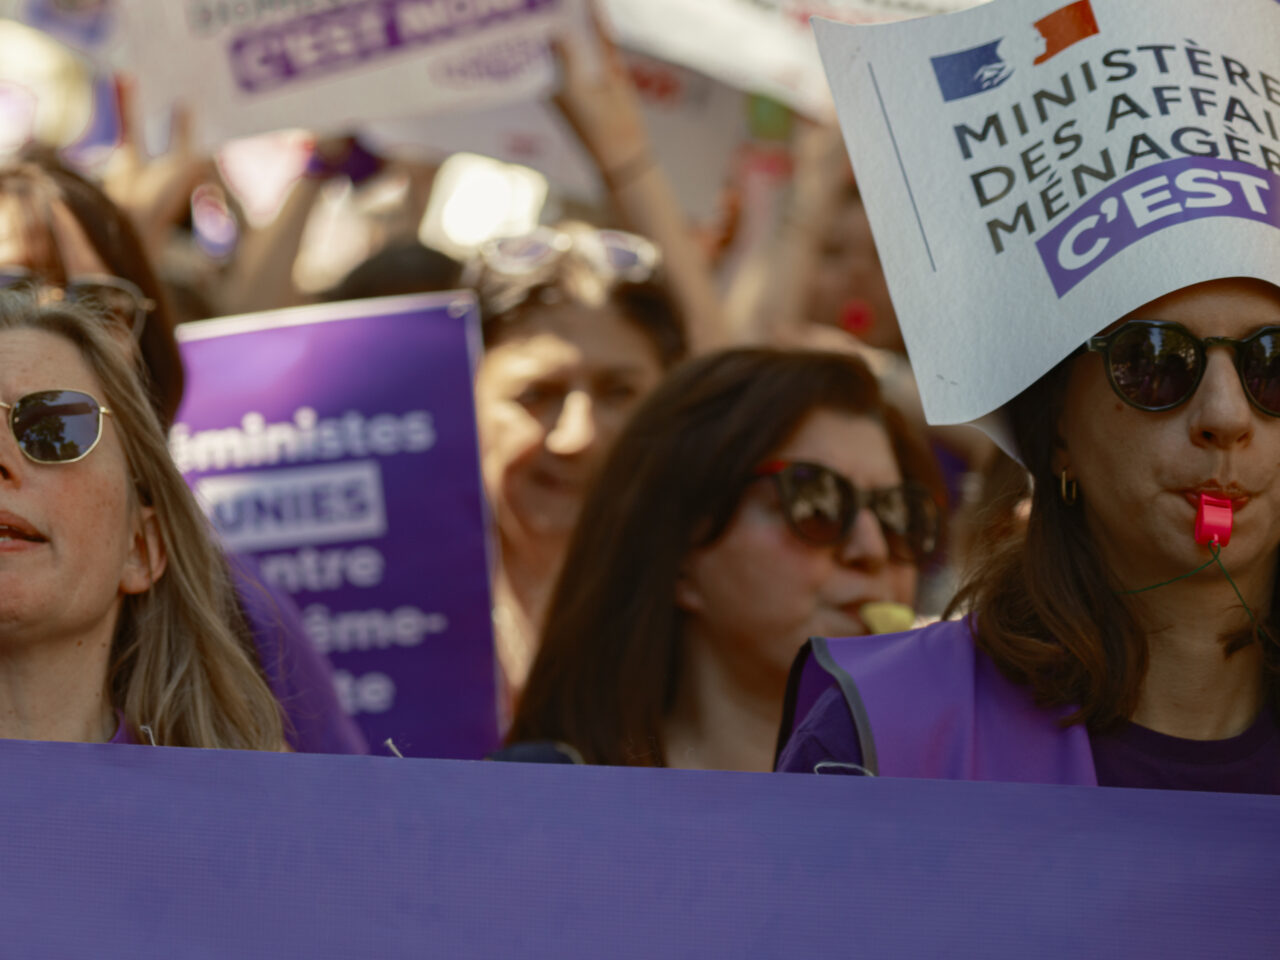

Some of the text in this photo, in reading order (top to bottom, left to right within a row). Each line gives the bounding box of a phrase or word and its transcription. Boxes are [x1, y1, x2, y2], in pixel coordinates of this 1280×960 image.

[953, 38, 1280, 160] MINISTÈRE
[970, 119, 1084, 208] DES
[261, 546, 384, 593] ntre
